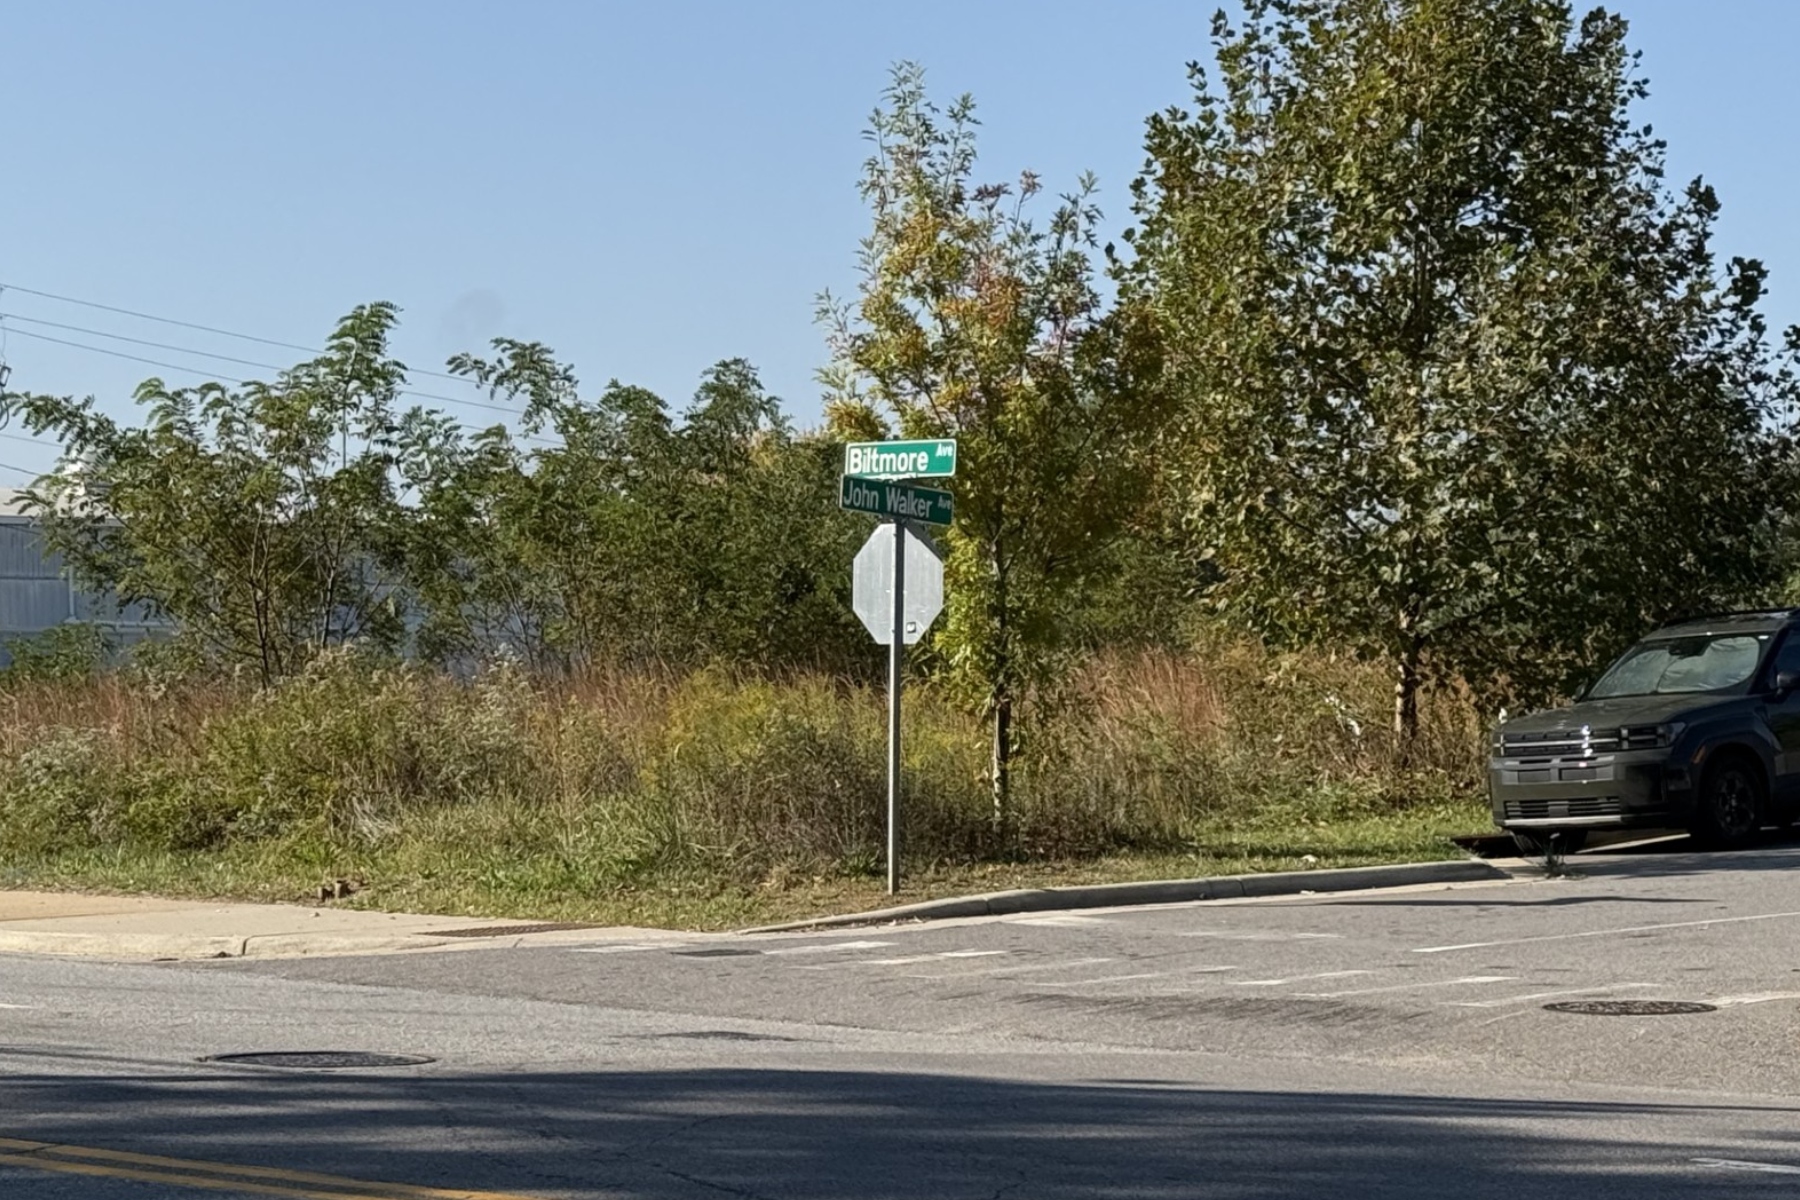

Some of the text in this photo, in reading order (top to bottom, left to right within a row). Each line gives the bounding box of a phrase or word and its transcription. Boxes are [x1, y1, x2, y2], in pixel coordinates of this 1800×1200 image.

[849, 443, 953, 474] Biltmore Ave
[843, 480, 952, 518] John Walker Ave
